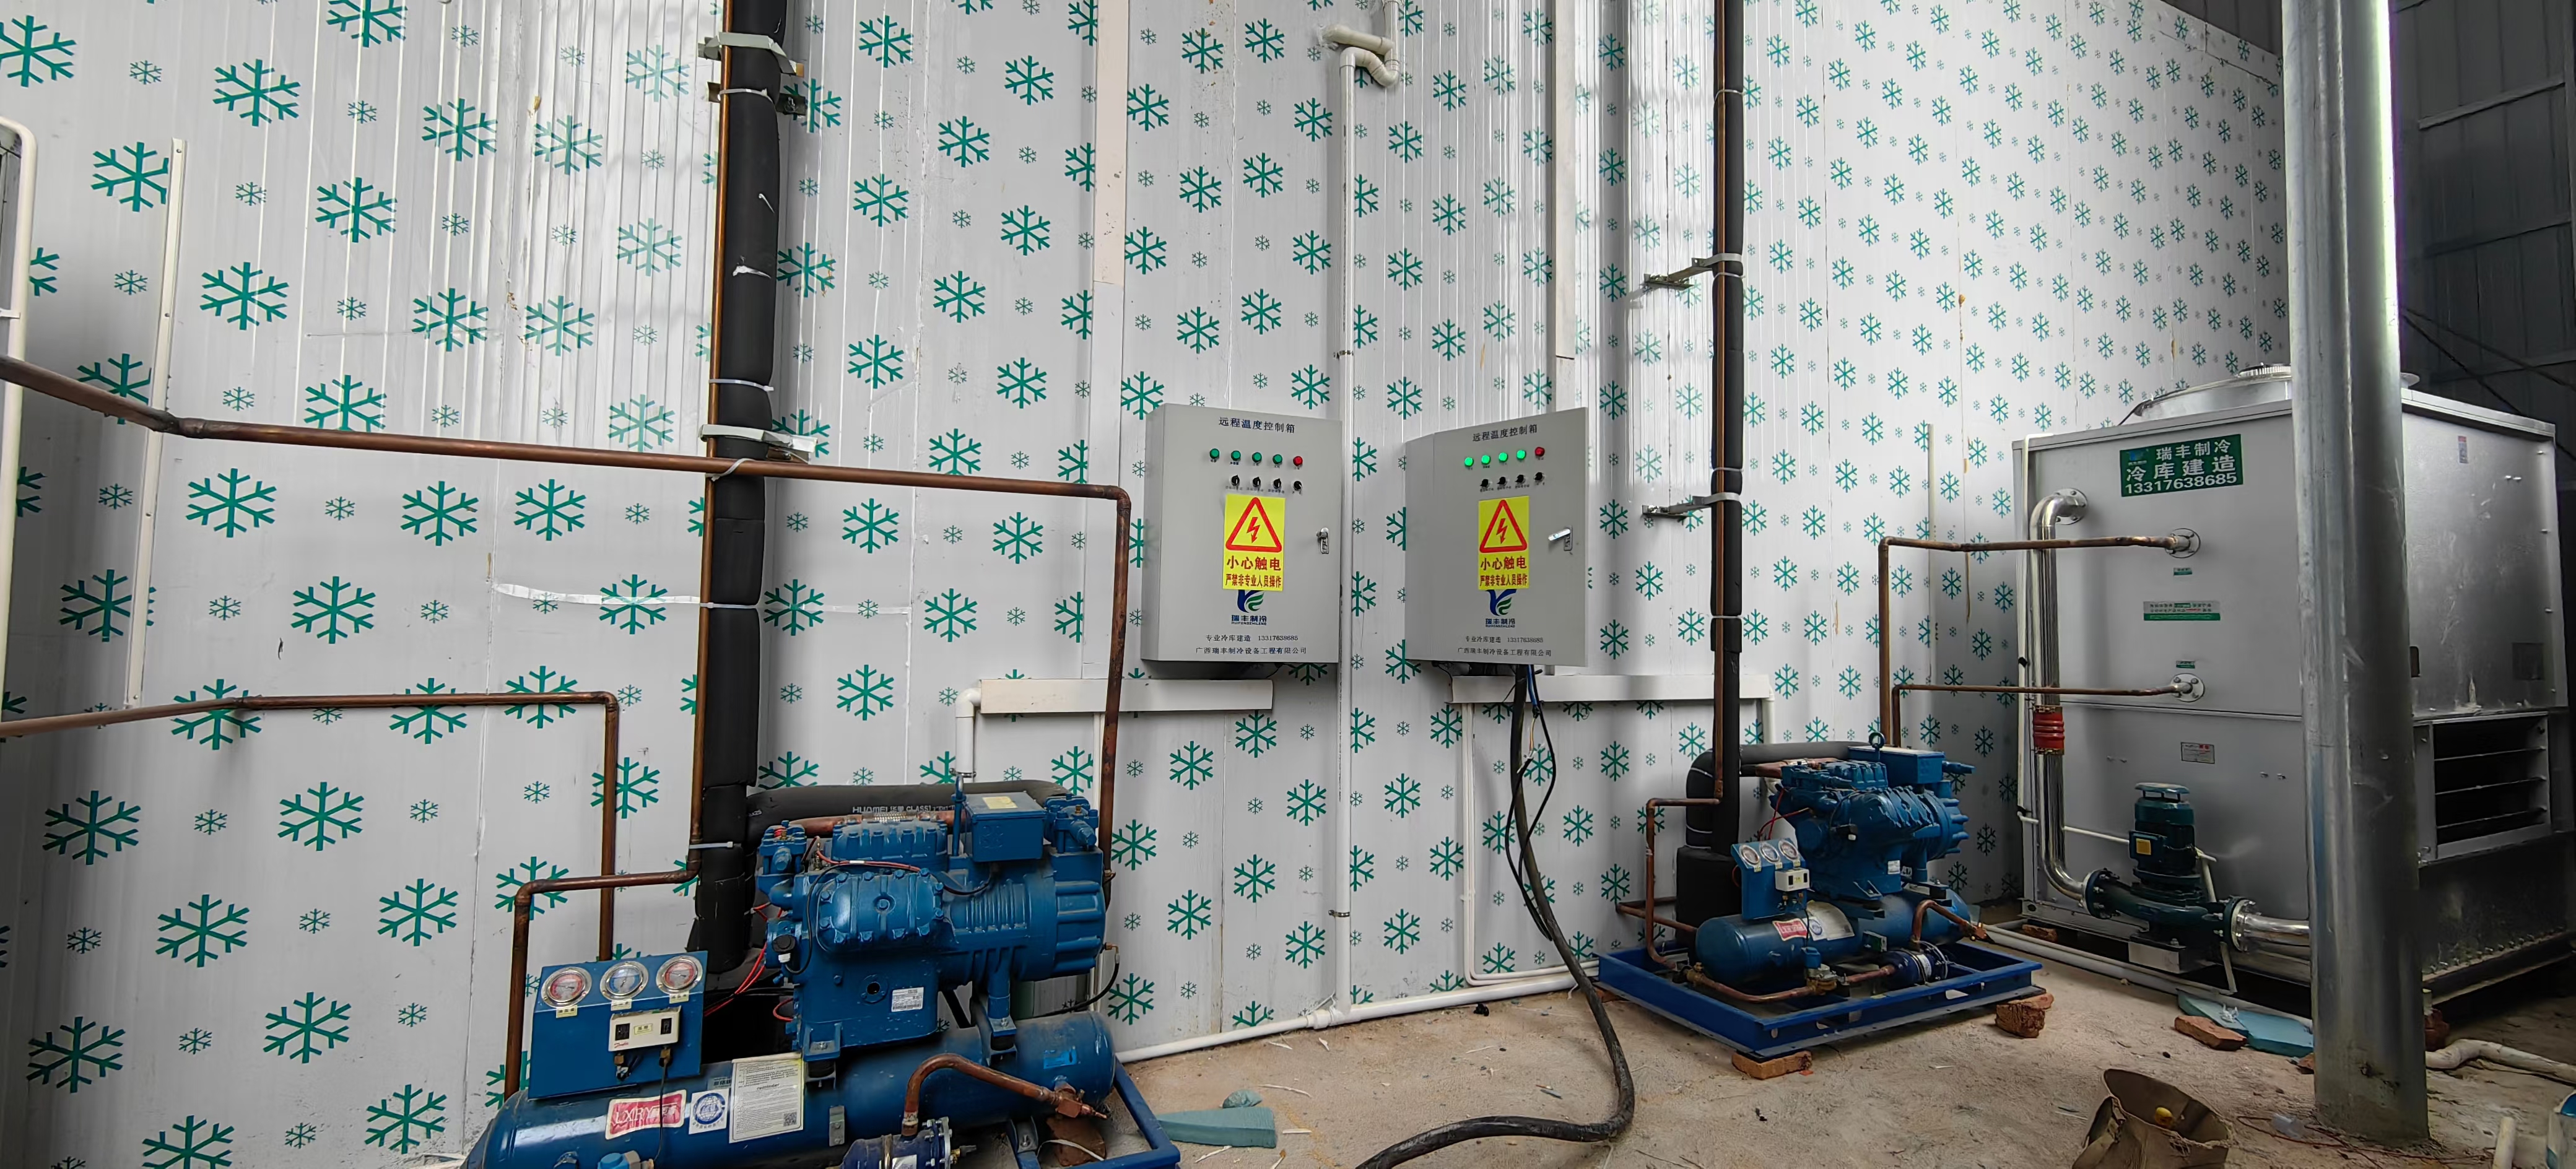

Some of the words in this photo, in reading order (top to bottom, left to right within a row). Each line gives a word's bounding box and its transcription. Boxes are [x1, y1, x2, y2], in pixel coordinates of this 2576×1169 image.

[1219, 417, 1295, 433] 远程温度控制箱
[1473, 424, 1538, 442] 远程温度控制箱
[2156, 439, 2231, 461] 瑞丰制冷
[2126, 454, 2236, 482] 冷库建造
[2125, 472, 2237, 495] 13317638685
[1226, 556, 1281, 571] 小心触电
[1480, 556, 1528, 570] 小心触电
[1225, 573, 1282, 588] 严禁非专业人员操作
[1479, 573, 1528, 587] 严禁非专业人员操作
[1206, 634, 1251, 642] 专业冷库建造
[1458, 647, 1552, 657] 广西瑞丰制冷设备工程有限公司
